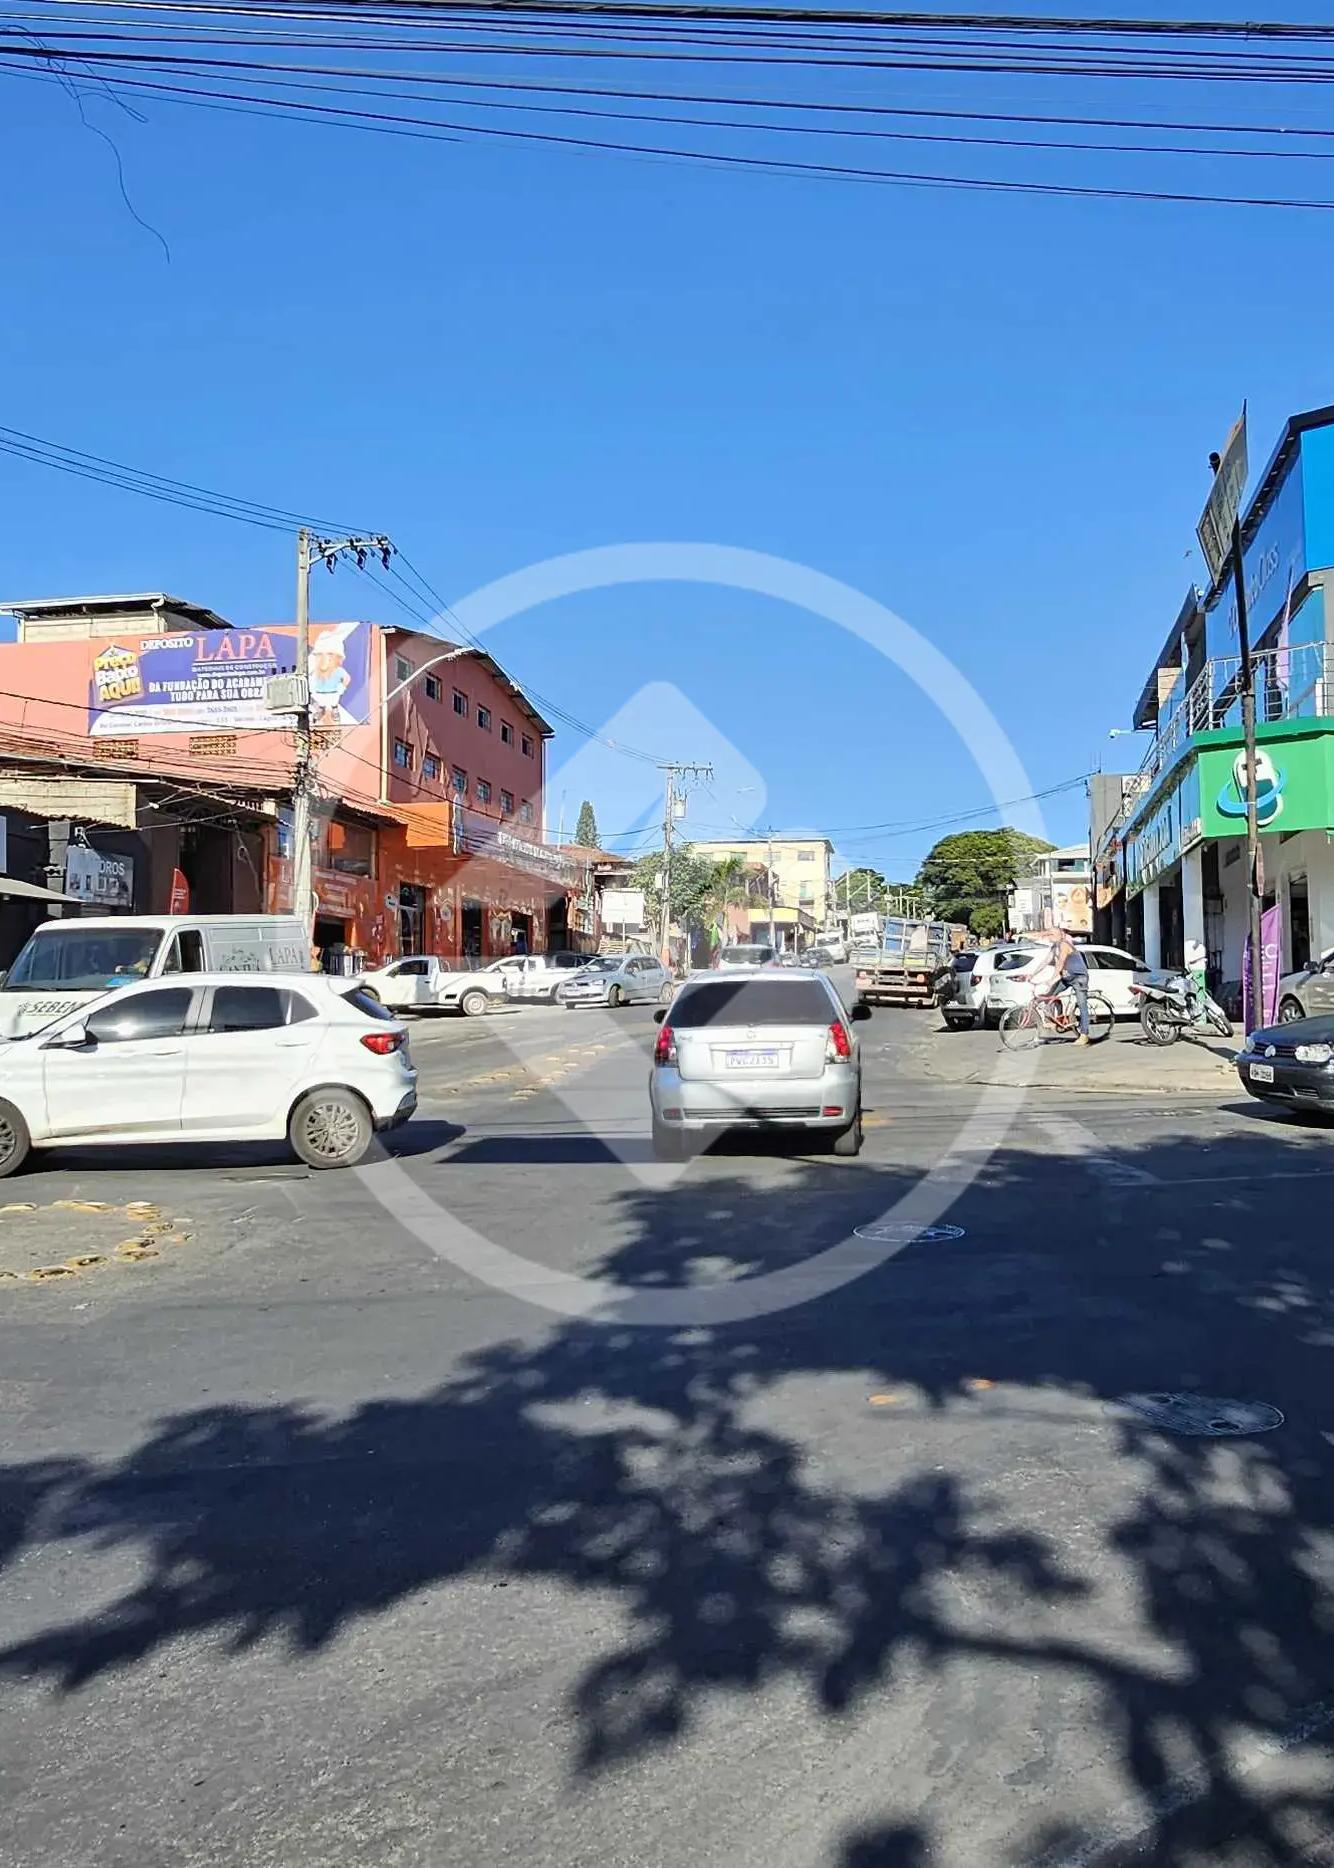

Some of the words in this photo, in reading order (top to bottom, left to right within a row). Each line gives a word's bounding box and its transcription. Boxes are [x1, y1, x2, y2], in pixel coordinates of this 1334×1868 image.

[193, 633, 277, 662] LAPA
[149, 682, 160, 692] DA
[162, 677, 209, 694] FUNDAÇÃO
[170, 691, 194, 702] TUDO
[195, 689, 218, 701] PARA
[220, 688, 239, 699] SUA
